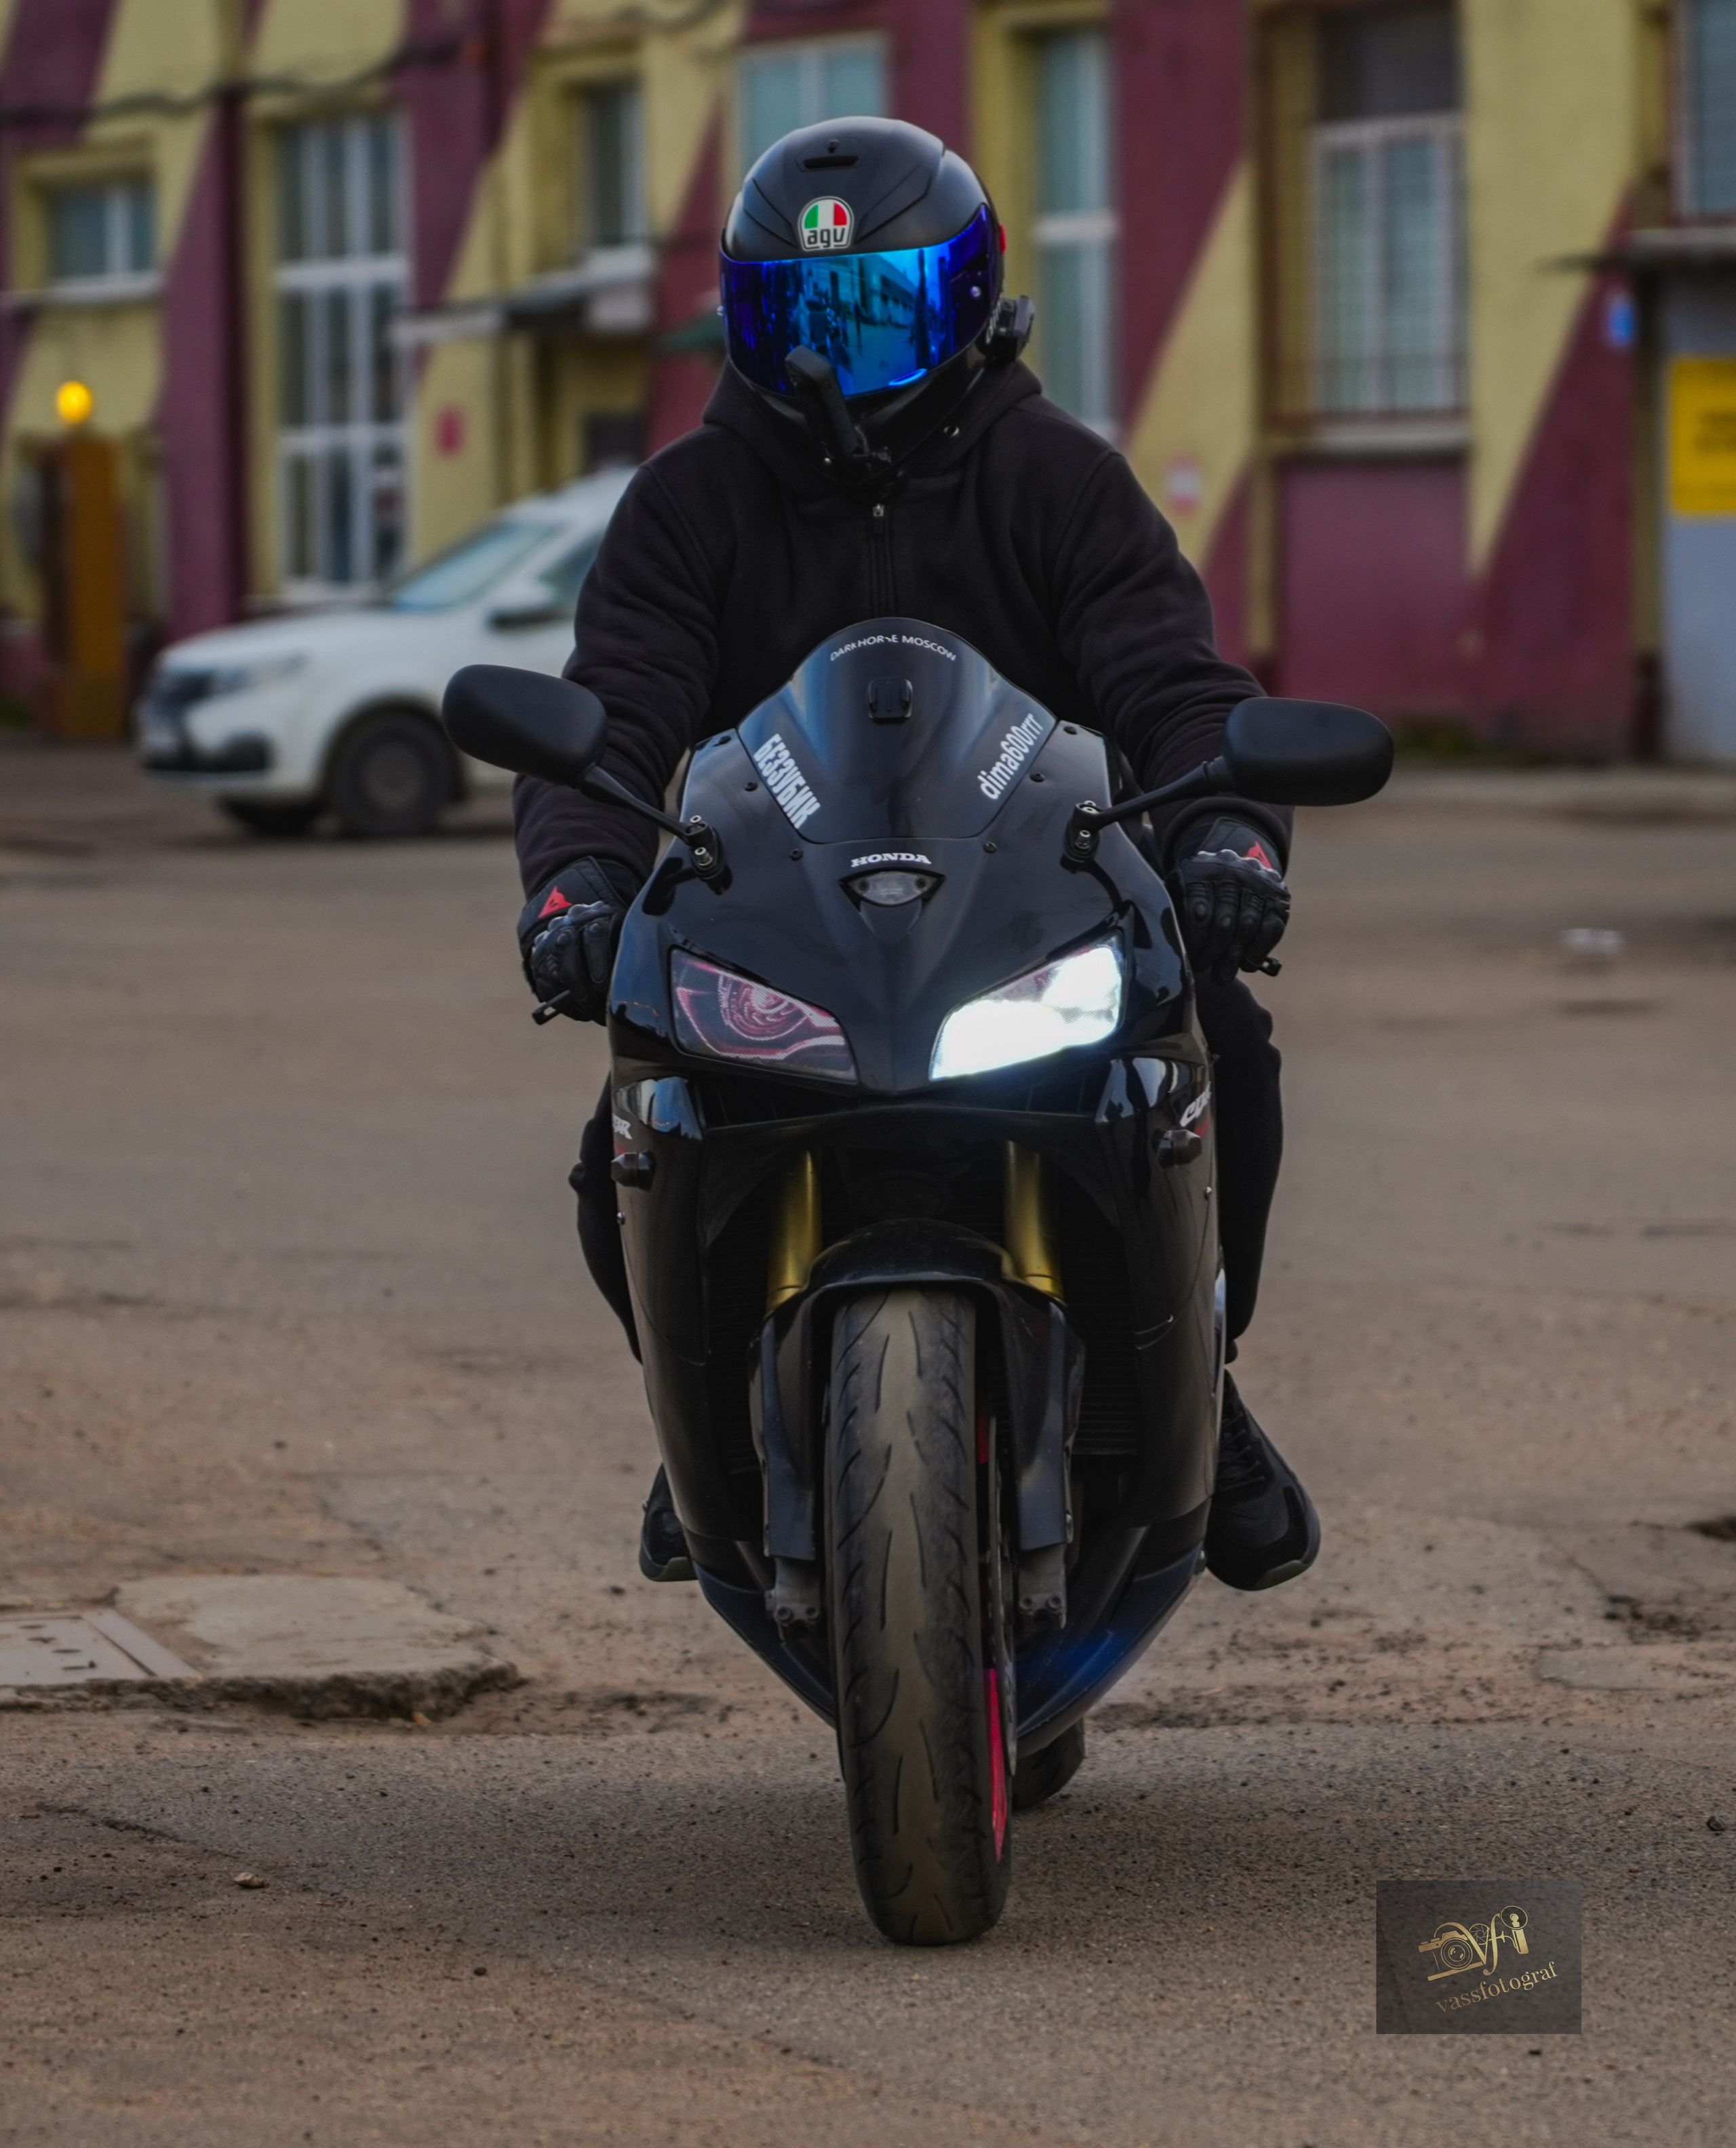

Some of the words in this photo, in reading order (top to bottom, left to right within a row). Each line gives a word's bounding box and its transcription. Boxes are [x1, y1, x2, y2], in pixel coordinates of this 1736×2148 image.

[807, 228, 846, 248] agv
[902, 635, 957, 661] MOSCOW
[977, 713, 1043, 799] dima600rrr
[753, 733, 821, 829] БЕЗЗУБИК
[850, 852, 932, 868] HONDA
